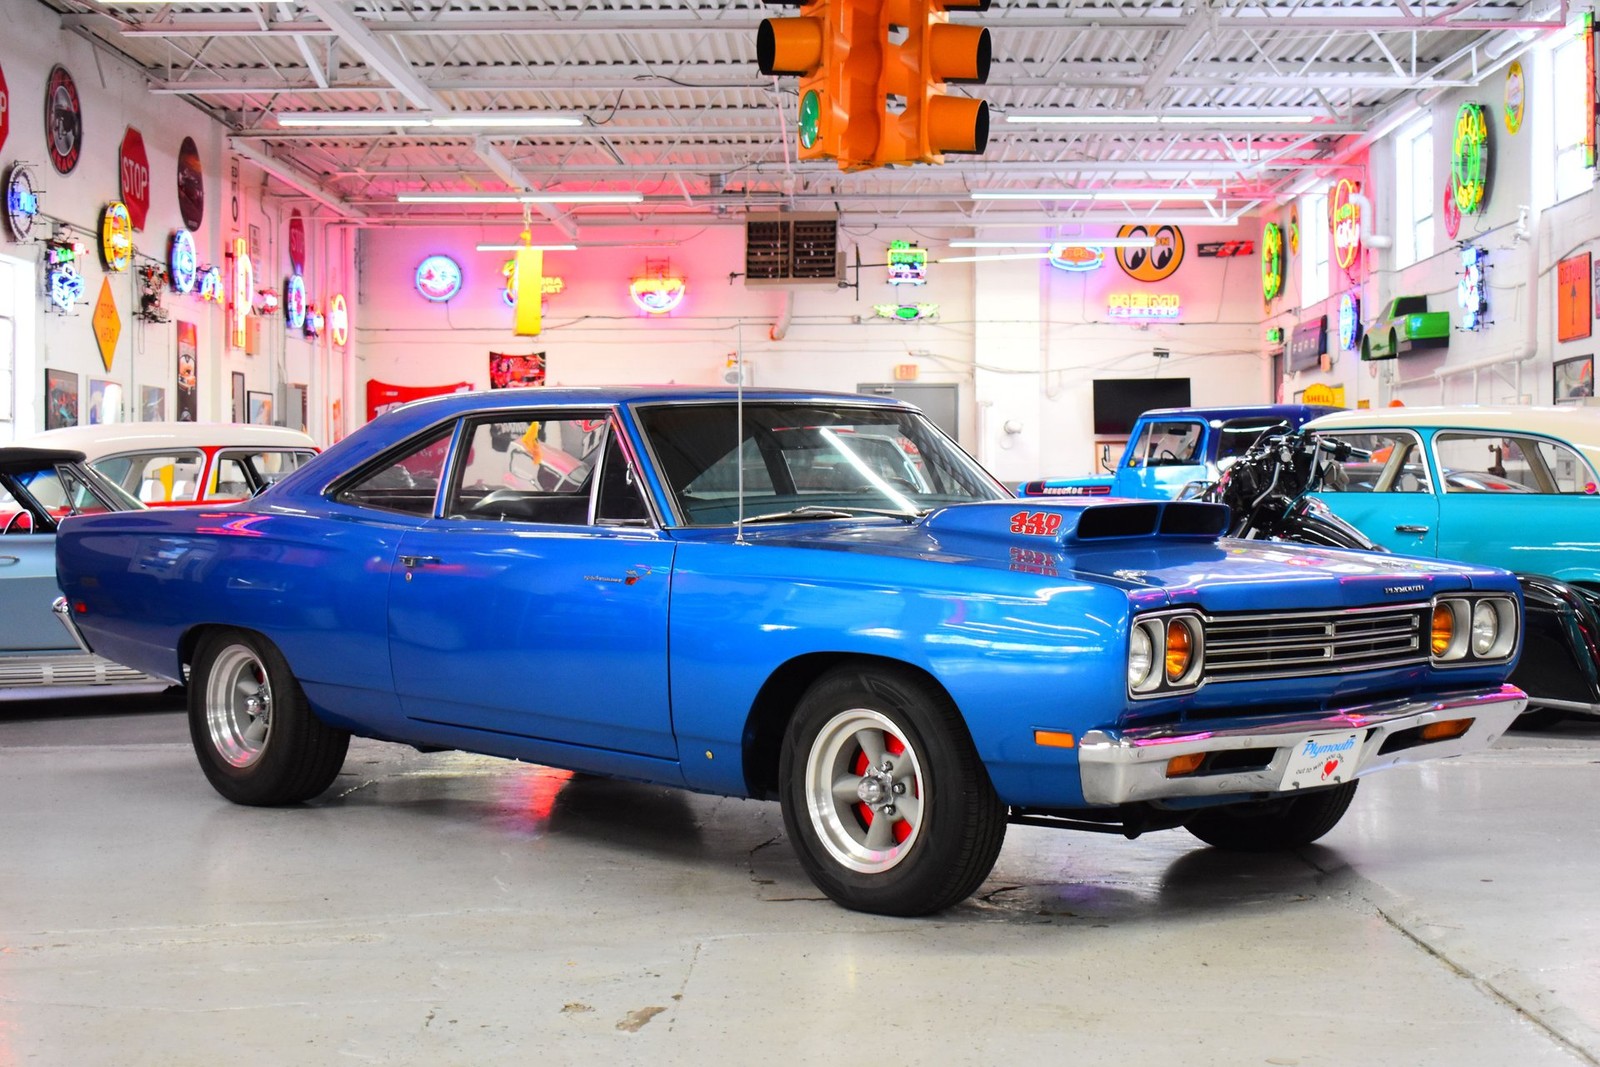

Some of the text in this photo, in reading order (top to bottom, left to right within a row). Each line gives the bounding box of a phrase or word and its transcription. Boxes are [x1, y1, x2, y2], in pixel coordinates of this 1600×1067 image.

[122, 156, 148, 201] STOP
[1560, 259, 1588, 285] DETOUR
[1293, 338, 1315, 354] FORD
[1306, 395, 1330, 403] SHELL
[1042, 486, 1084, 495] RENEGADE
[1010, 511, 1062, 530] 440
[1384, 584, 1424, 594] PLYMOUTH
[1302, 738, 1356, 758] Plymouth
